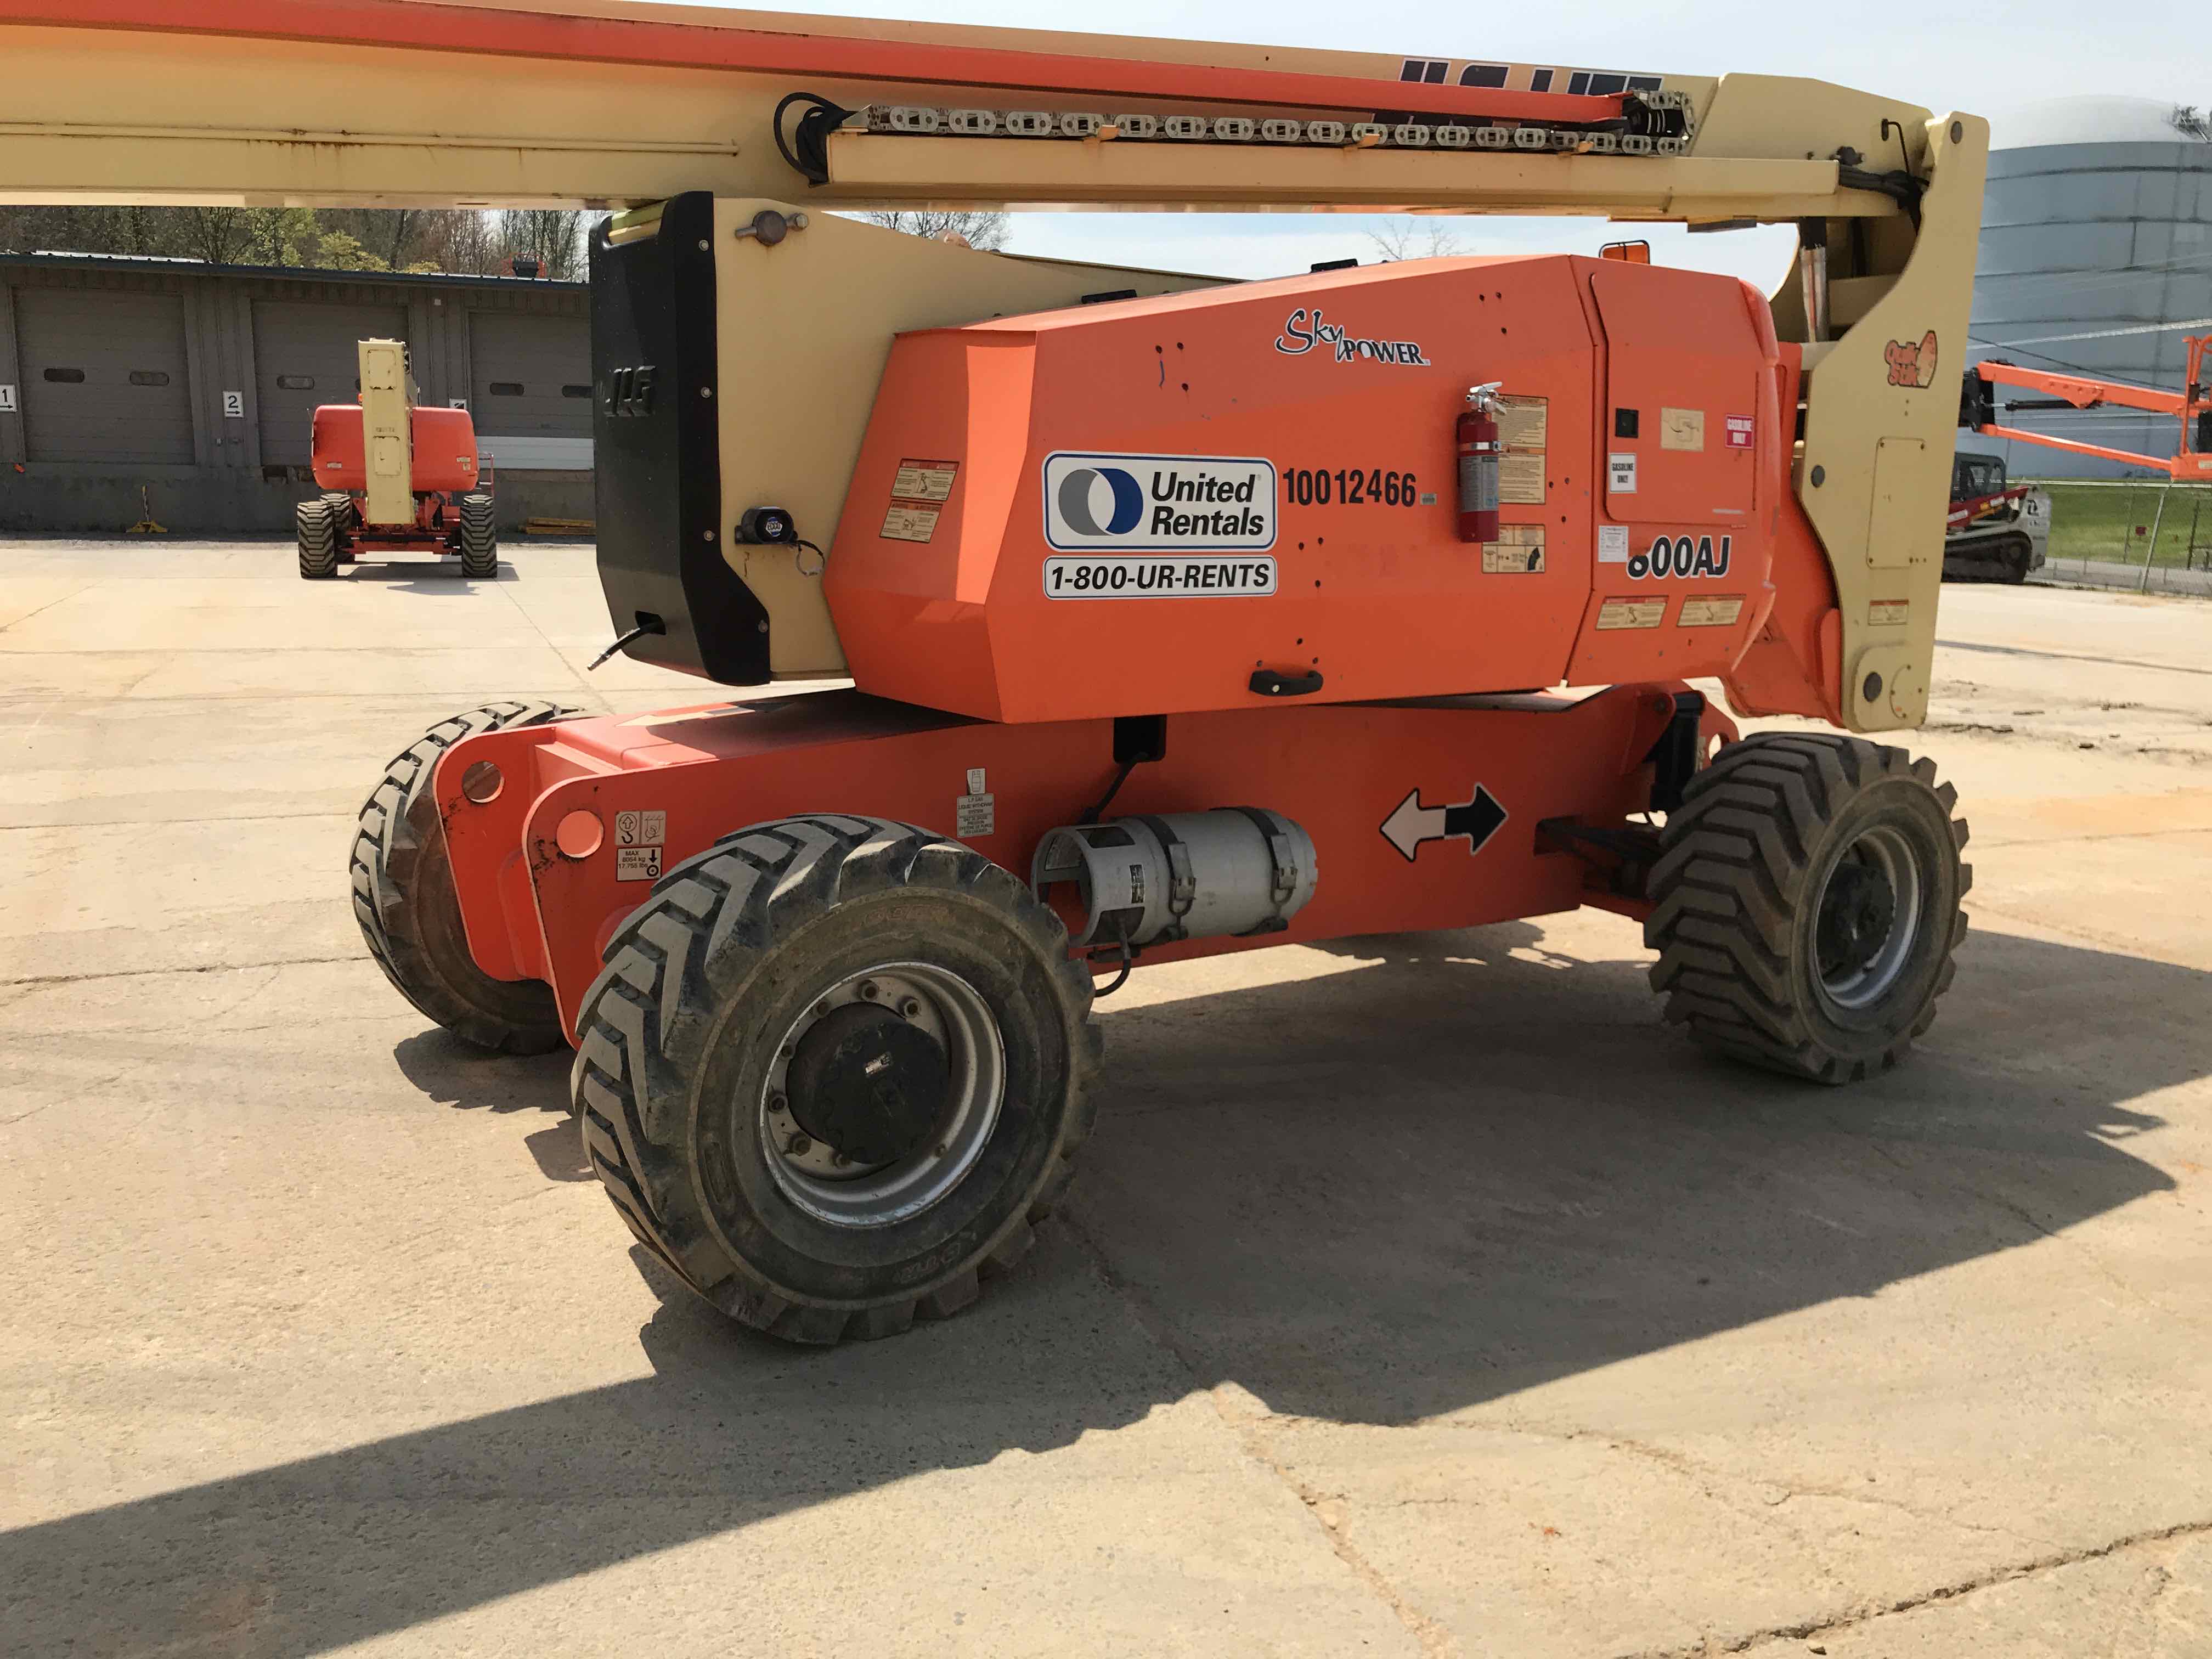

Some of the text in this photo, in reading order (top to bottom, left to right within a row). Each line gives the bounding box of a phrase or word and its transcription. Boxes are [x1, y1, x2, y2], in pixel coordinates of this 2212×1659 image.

[1275, 309, 1425, 364] Sky POWER
[2, 388, 8, 402] 1
[228, 395, 238, 408] 2
[1152, 471, 1256, 503] United
[1283, 468, 1417, 507] 10012466
[1150, 506, 1265, 536] Rentals
[1051, 563, 1270, 590] 1-800-UR-RENTS
